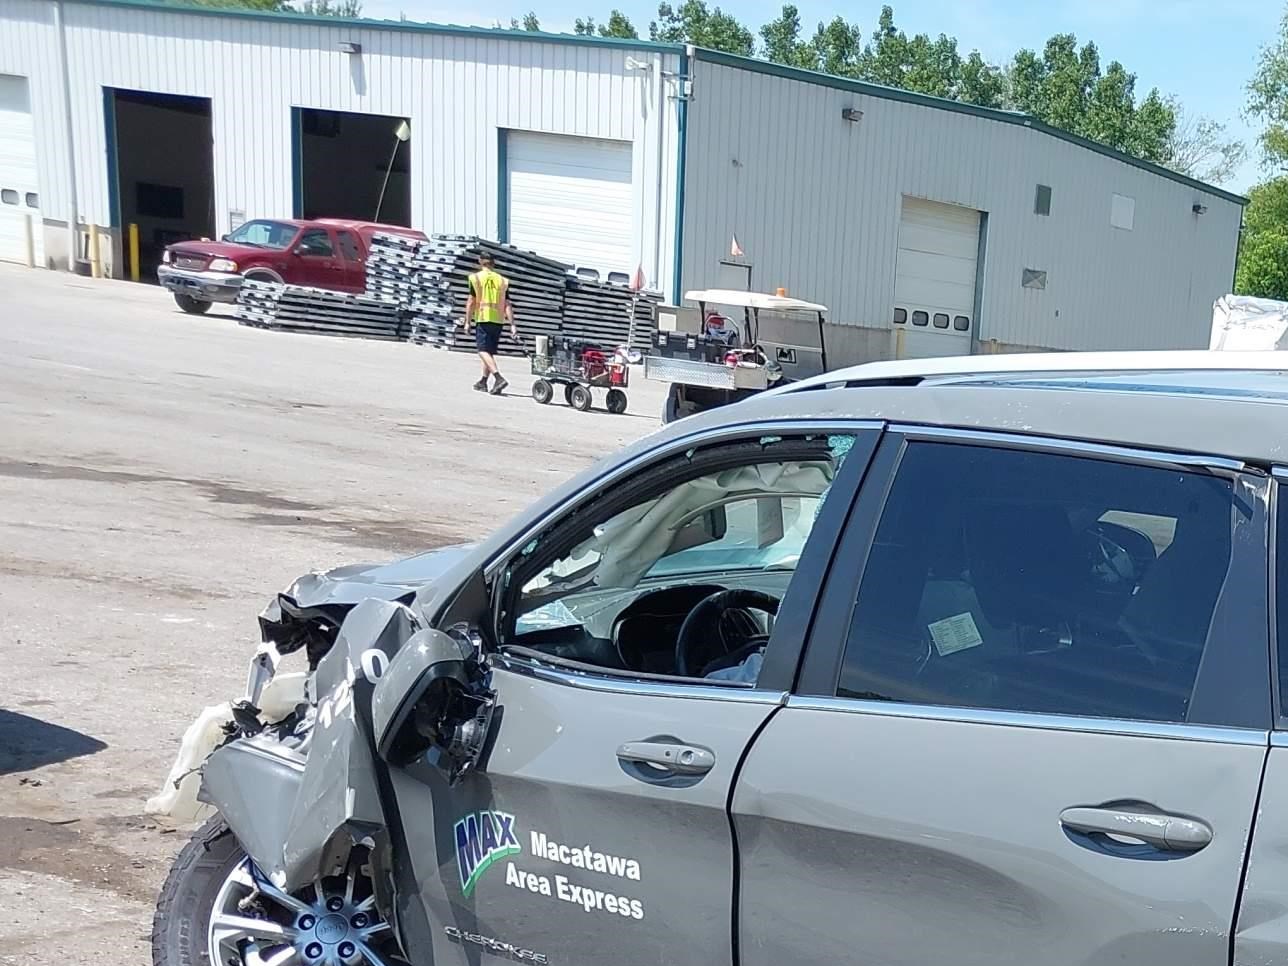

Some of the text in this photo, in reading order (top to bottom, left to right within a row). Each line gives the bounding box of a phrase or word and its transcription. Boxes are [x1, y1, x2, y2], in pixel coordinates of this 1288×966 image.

[454, 811, 521, 895] MAX
[530, 831, 641, 880] Macatawa
[506, 862, 644, 920] Area Express
[444, 926, 550, 966] CHEROKEE
